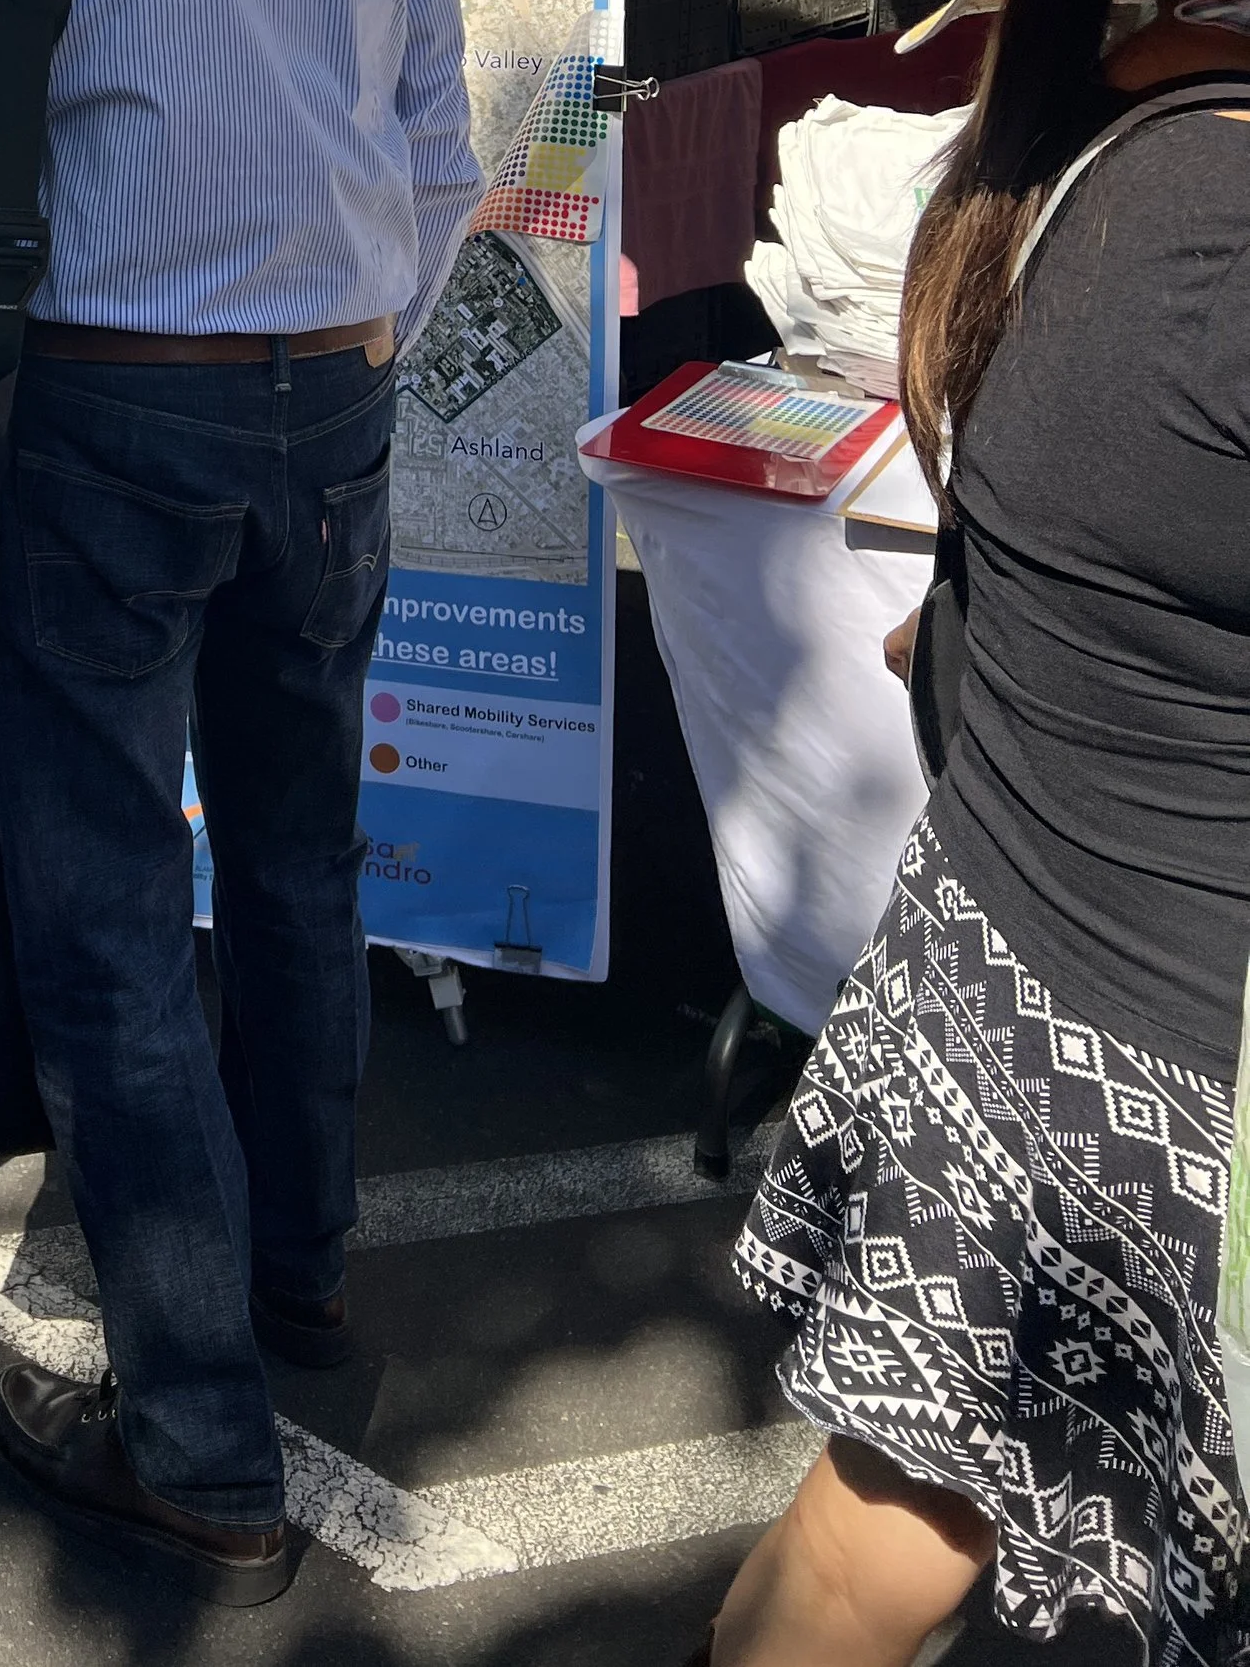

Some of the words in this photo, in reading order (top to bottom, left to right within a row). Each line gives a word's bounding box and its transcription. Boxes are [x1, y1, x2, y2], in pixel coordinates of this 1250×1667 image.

[475, 49, 543, 75] Valley
[451, 436, 544, 461] Ashland
[458, 647, 558, 677] areas!
[406, 698, 460, 717] Shared
[464, 705, 524, 728] Mobility
[527, 713, 596, 733] Services
[405, 755, 448, 773] Other
